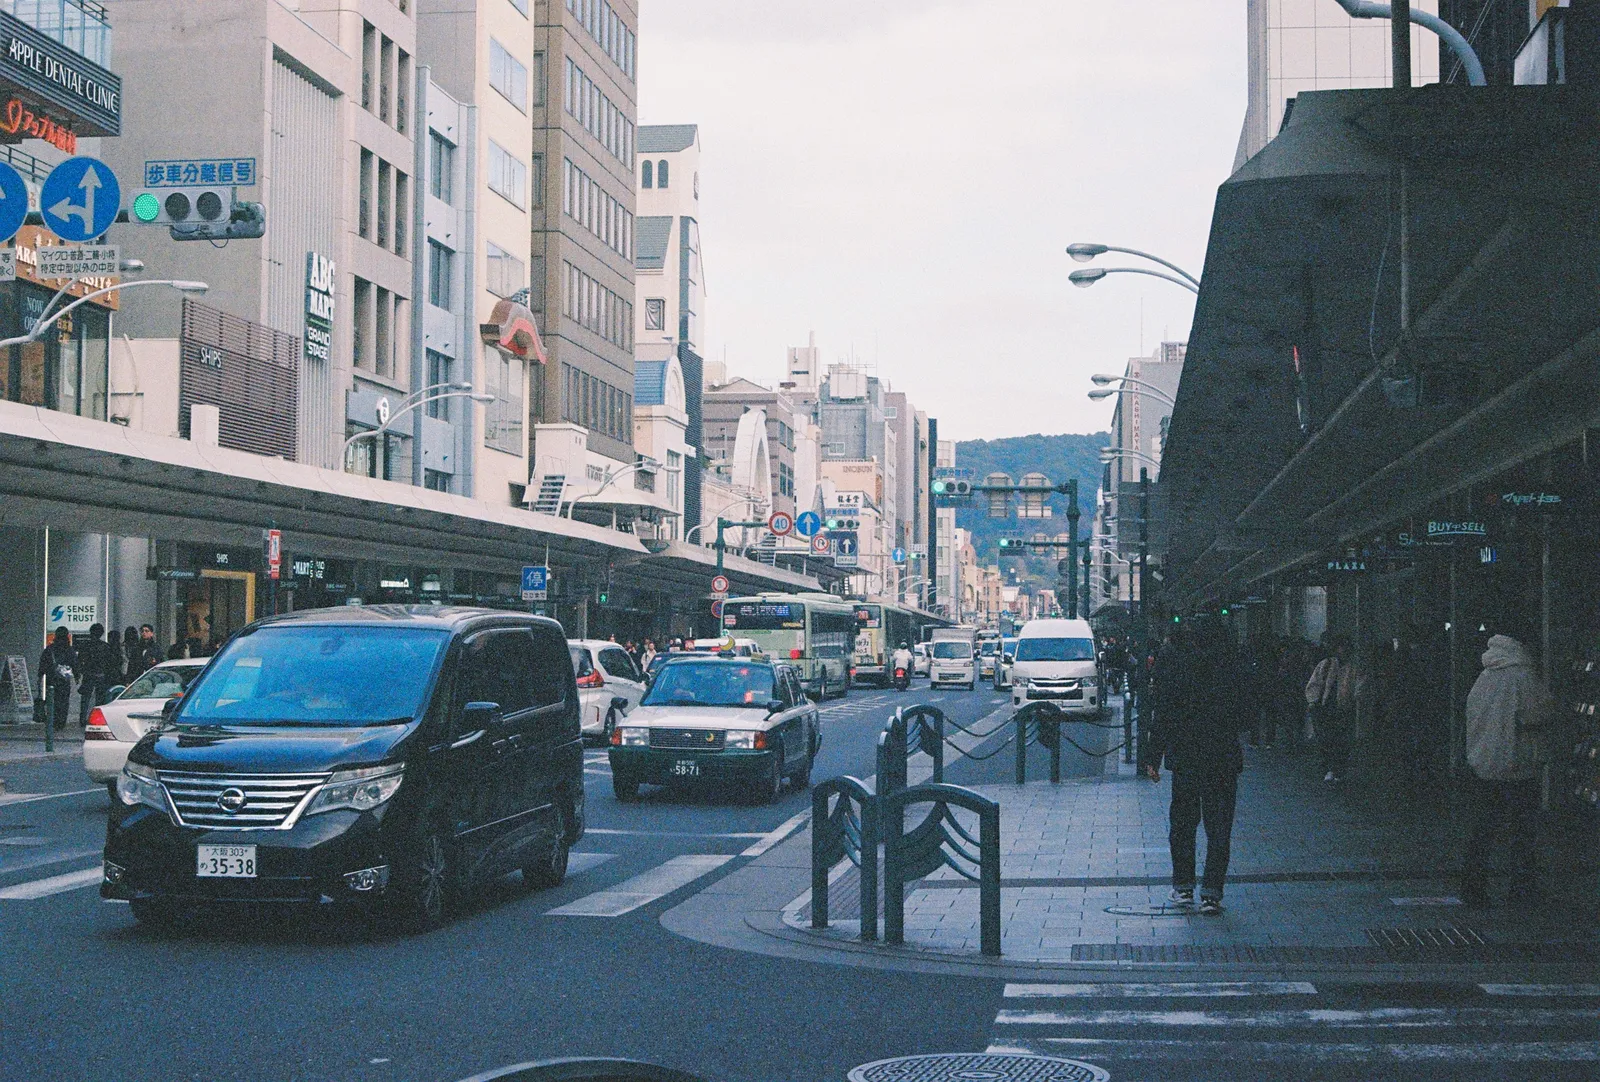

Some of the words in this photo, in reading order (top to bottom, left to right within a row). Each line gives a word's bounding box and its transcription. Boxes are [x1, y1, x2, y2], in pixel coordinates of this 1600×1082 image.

[9, 38, 43, 73] APPLE
[45, 57, 84, 96] DENTAL
[86, 79, 118, 113] CLINIC
[148, 161, 251, 184] 歩車分離信号
[41, 262, 115, 274] 特定中型以外の中型
[310, 252, 335, 295] ABC
[310, 289, 335, 321] MART
[308, 326, 331, 346] GRAND
[200, 347, 222, 368] SHIPS
[308, 341, 328, 360] STAGE
[843, 465, 873, 473] INOBUN
[774, 517, 788, 530] 40
[1461, 522, 1486, 532] SELL
[216, 553, 229, 564] SHIPS
[1327, 561, 1366, 570] PLAZA
[526, 571, 543, 587] 停
[67, 605, 95, 613] SENSE
[67, 614, 95, 622] TRUST
[210, 858, 254, 875] 35-38
